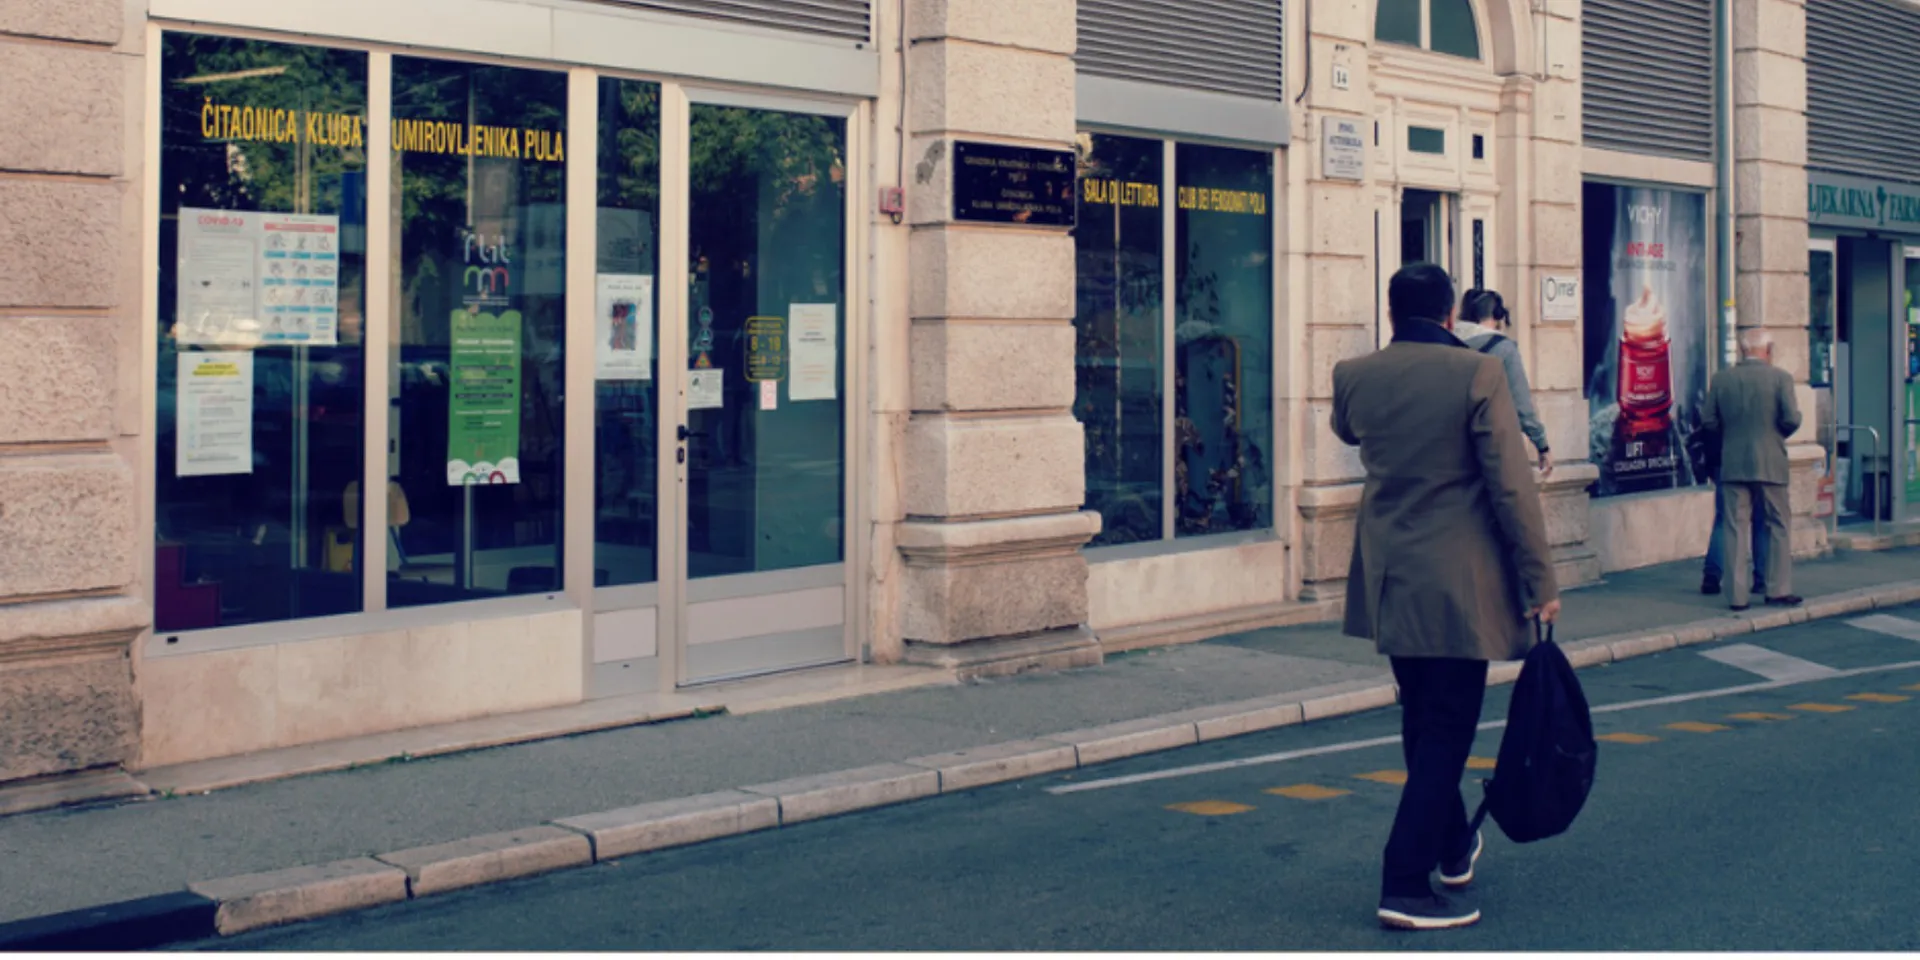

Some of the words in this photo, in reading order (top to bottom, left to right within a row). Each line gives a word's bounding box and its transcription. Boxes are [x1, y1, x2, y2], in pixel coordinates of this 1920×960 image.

[201, 96, 298, 144] ČITAONICA
[305, 111, 363, 147] KLUBA
[391, 118, 520, 158] UMIROVLJENIKA
[524, 129, 565, 162] PULA
[1084, 177, 1108, 204] SALA
[1121, 181, 1160, 208] LETTURA
[1178, 184, 1197, 209] CLUB
[1808, 183, 1875, 221] LJEKARNA
[1627, 203, 1663, 225] VICHY
